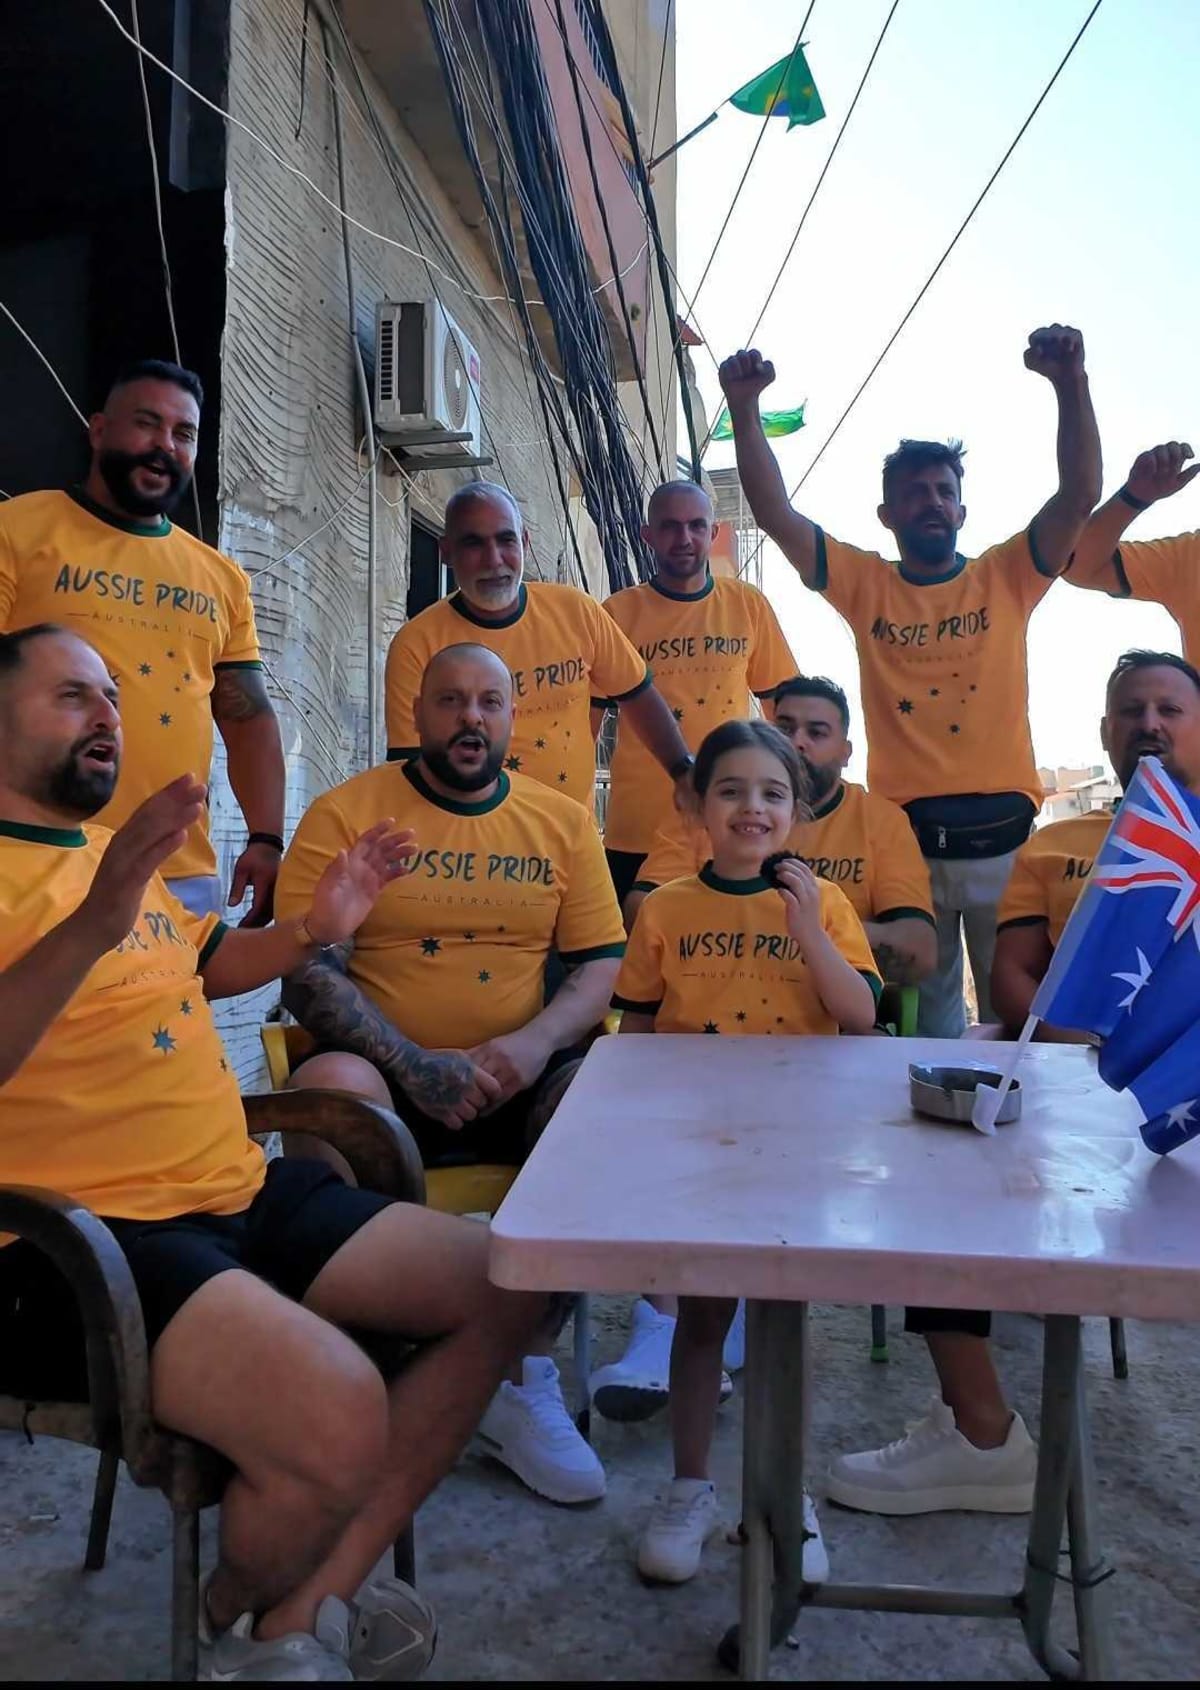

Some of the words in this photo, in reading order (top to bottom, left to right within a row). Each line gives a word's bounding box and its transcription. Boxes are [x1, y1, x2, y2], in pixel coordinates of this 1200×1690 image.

[54, 563, 144, 606] AUSSIE
[156, 583, 218, 623] PRIDE
[936, 606, 990, 641] PRIDE
[703, 635, 748, 657] PRIDE
[533, 656, 585, 692] PRIDE
[398, 849, 476, 882] USSIE
[487, 853, 554, 886] PRIDE
[808, 857, 865, 884] PRIDE
[420, 892, 528, 907] AUSTRALIA
[679, 932, 746, 961] AUSSIE
[753, 934, 807, 965] PRID
